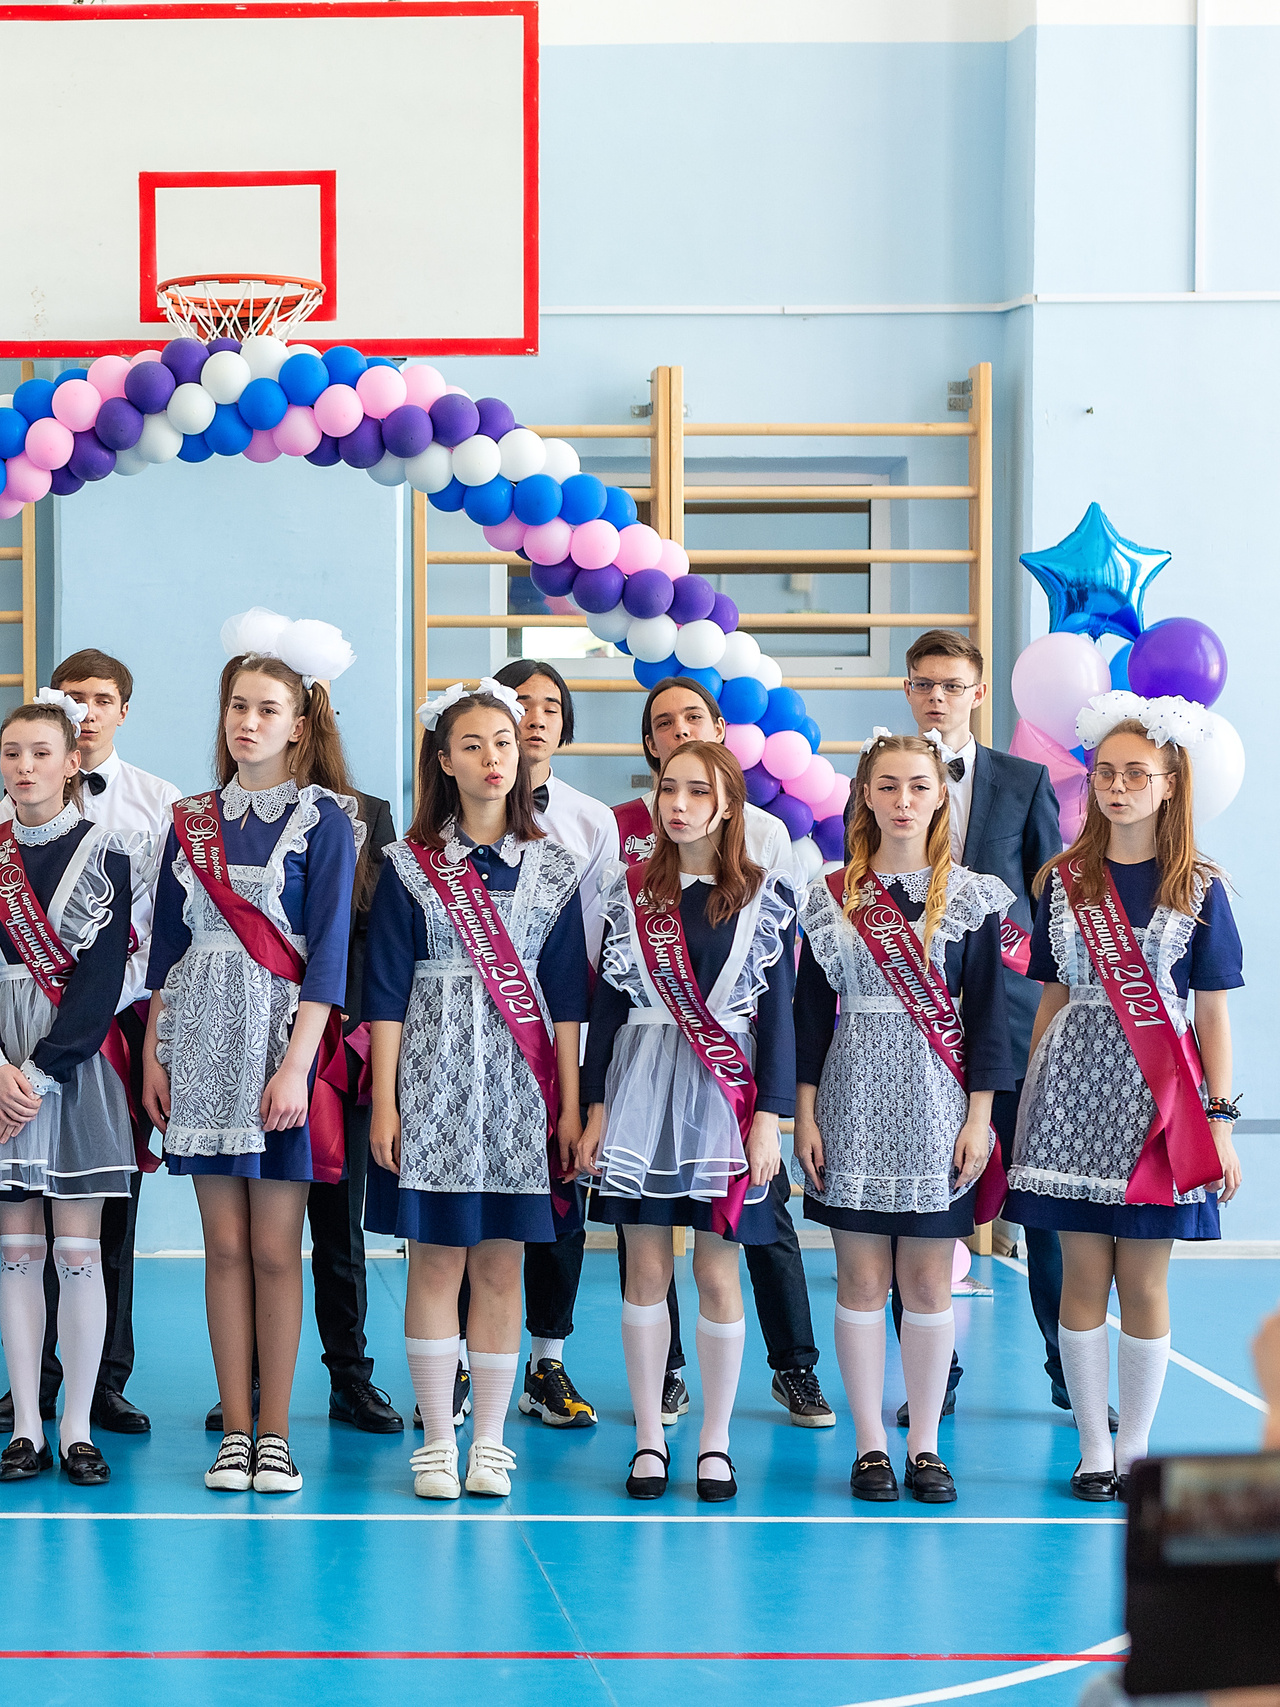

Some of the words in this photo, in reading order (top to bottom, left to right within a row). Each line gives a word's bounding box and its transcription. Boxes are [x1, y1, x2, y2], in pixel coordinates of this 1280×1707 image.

[210, 846, 223, 883] Коробко
[21, 892, 38, 920] Ларина
[35, 922, 67, 965] Анастасия
[430, 849, 498, 964] Выпускница
[488, 963, 540, 1023] 2021
[472, 888, 485, 906] Сим
[481, 907, 499, 935] Ирина
[1103, 885, 1121, 924] сырова
[1114, 924, 1132, 952] Софья
[645, 914, 703, 1031] Выпускница
[694, 1030, 749, 1087] 2021
[673, 944, 688, 979] Козлова
[684, 982, 714, 1026] Анастасия
[864, 904, 940, 1019] Выпускница
[930, 1013, 967, 1072] 202
[932, 987, 950, 1012] Дарья
[1111, 964, 1166, 1028] 2021
